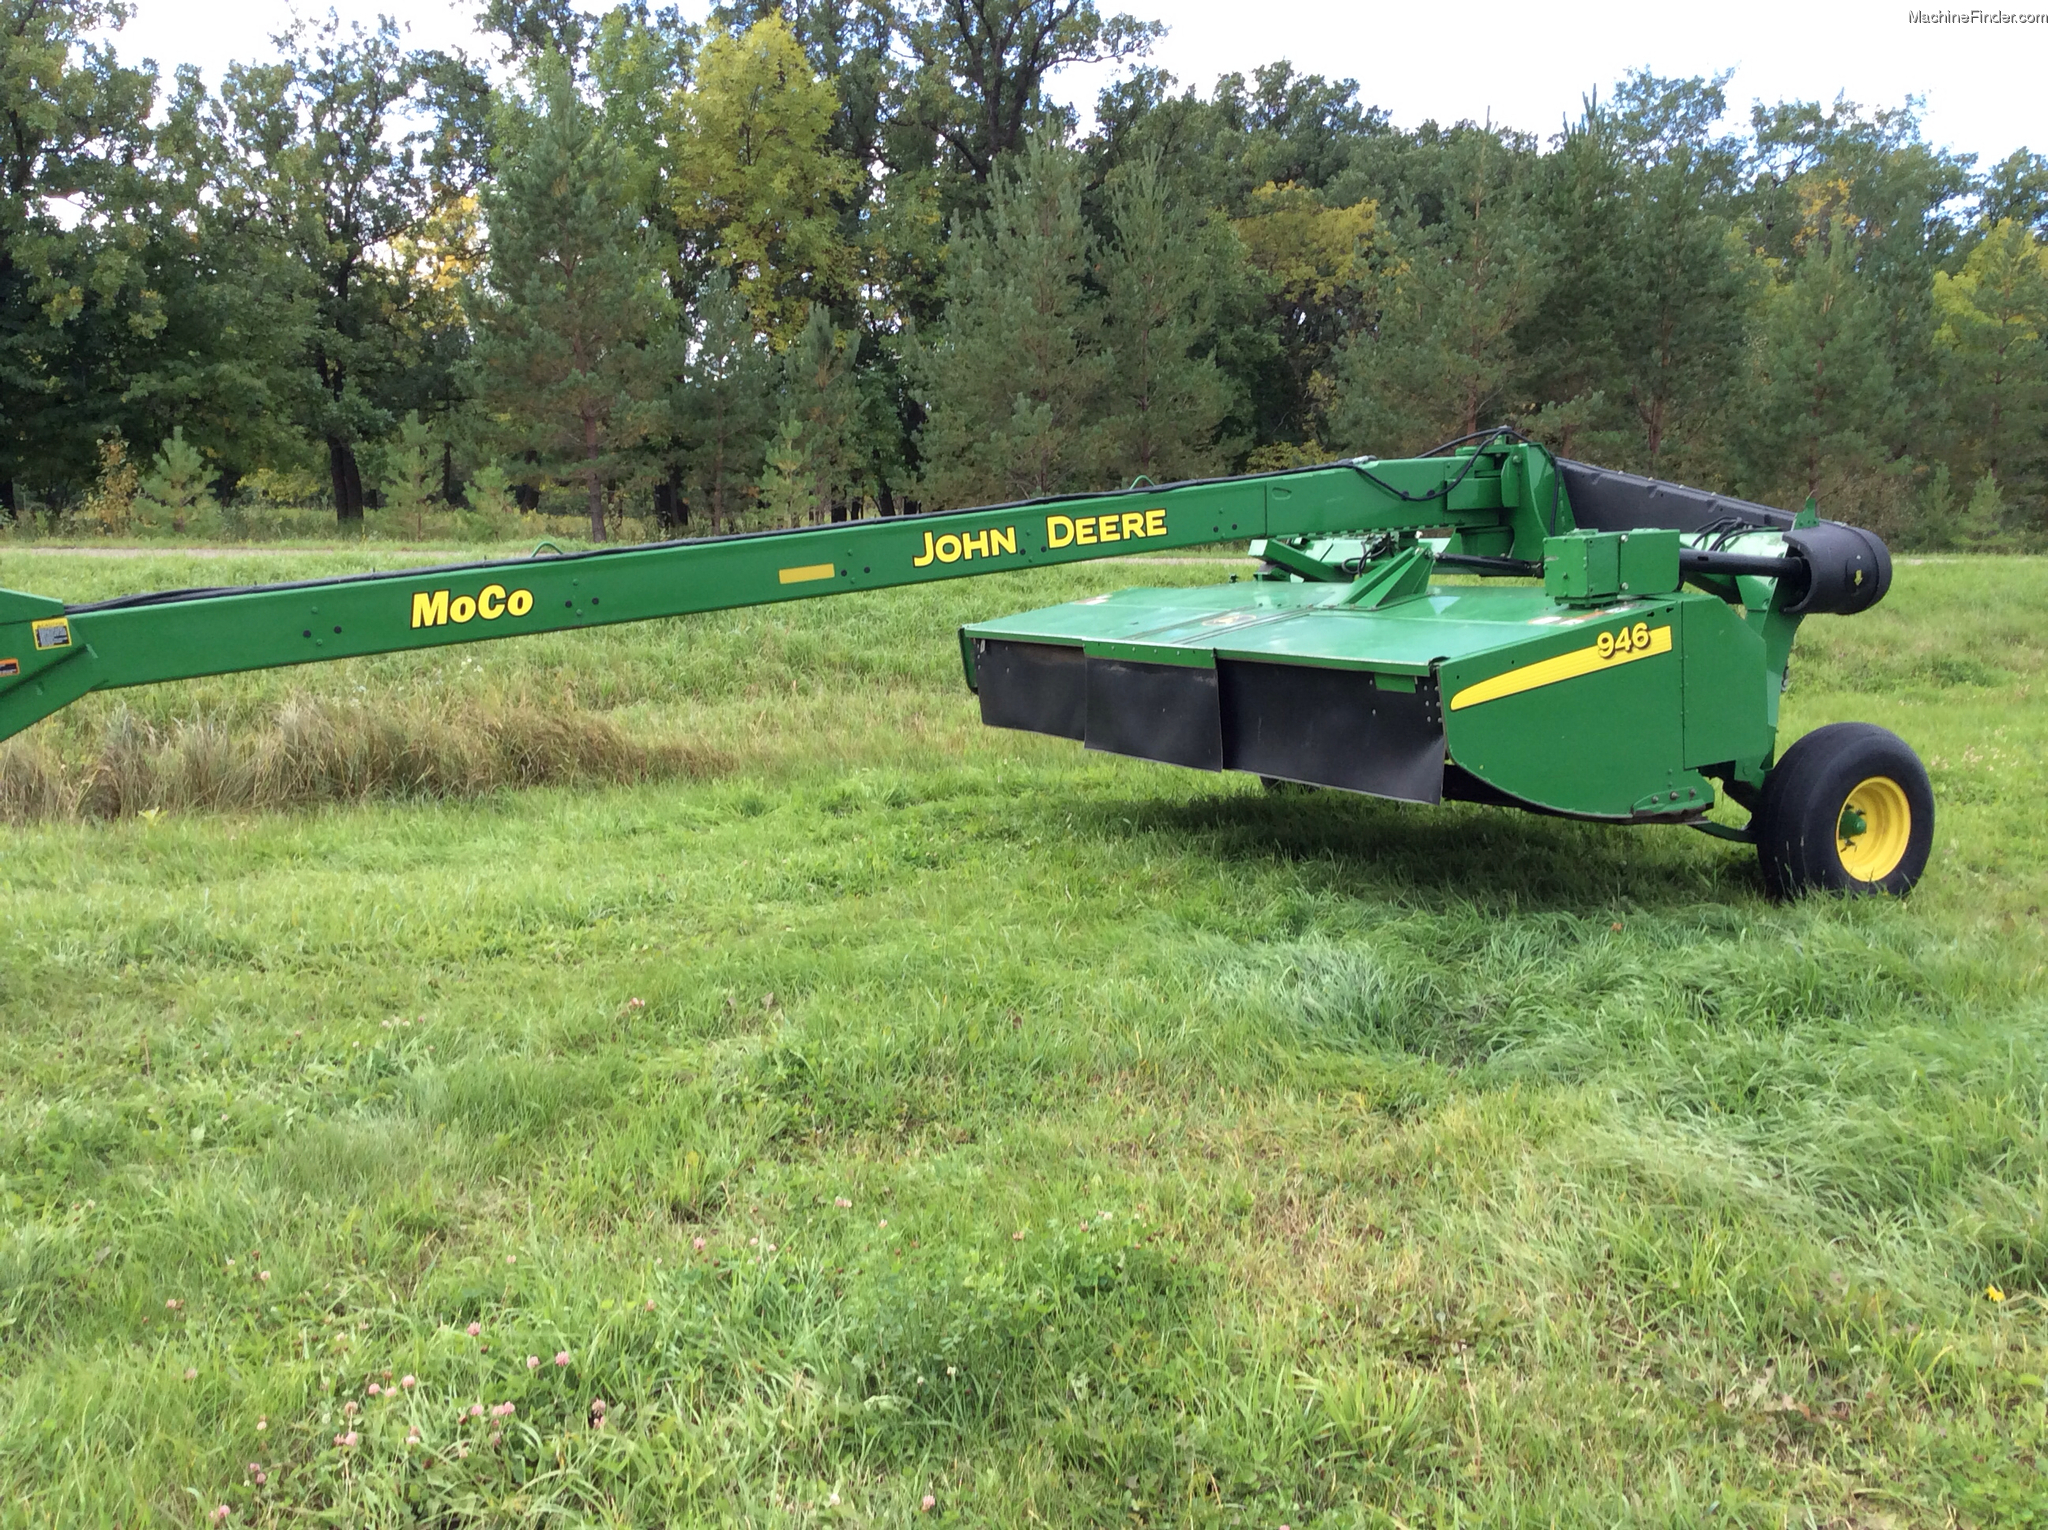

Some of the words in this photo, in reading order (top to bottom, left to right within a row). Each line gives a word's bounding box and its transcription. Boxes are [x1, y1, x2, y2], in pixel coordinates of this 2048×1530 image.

[913, 526, 1017, 567] JOHN
[1046, 508, 1168, 549] DEERE
[411, 583, 534, 629] MoCo
[1596, 621, 1650, 659] 946
